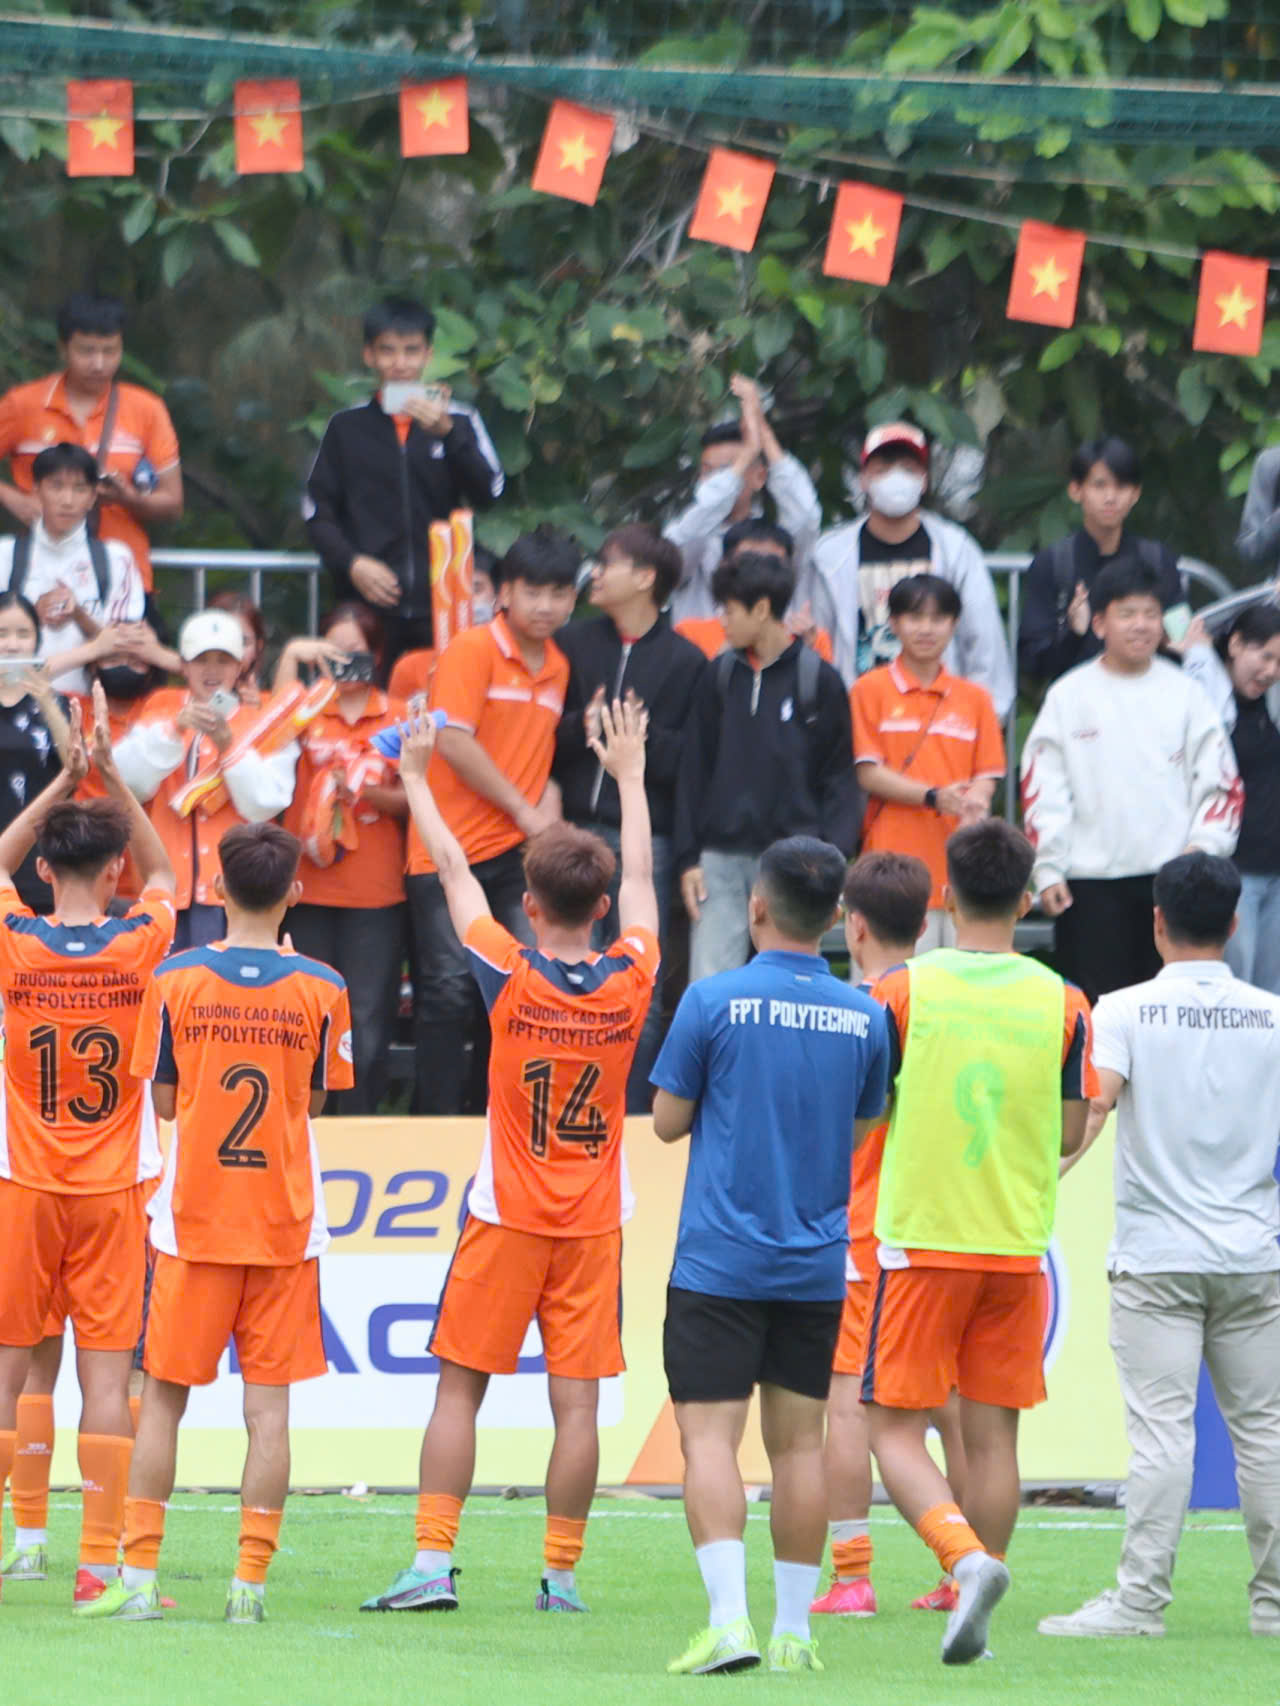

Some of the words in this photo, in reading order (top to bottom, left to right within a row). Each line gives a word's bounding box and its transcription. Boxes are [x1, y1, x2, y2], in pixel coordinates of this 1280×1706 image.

[71, 973, 97, 988] CAO
[6, 989, 32, 1007] FPT
[245, 1005, 269, 1022] CAO
[572, 1010, 597, 1025] CAO
[730, 998, 762, 1025] FPT
[770, 1000, 870, 1039] POLYTECHNIC
[1139, 1004, 1167, 1025] FPT
[1177, 1005, 1275, 1030] POLYTECHNIC
[184, 1025, 209, 1044] FPT
[211, 1025, 309, 1050] POLYTECHNIC
[507, 1018, 534, 1040] FPT
[538, 1024, 634, 1048] POLYTECHNIC
[29, 1024, 120, 1123] 13
[217, 1063, 270, 1169] 2
[524, 1059, 608, 1160] 14
